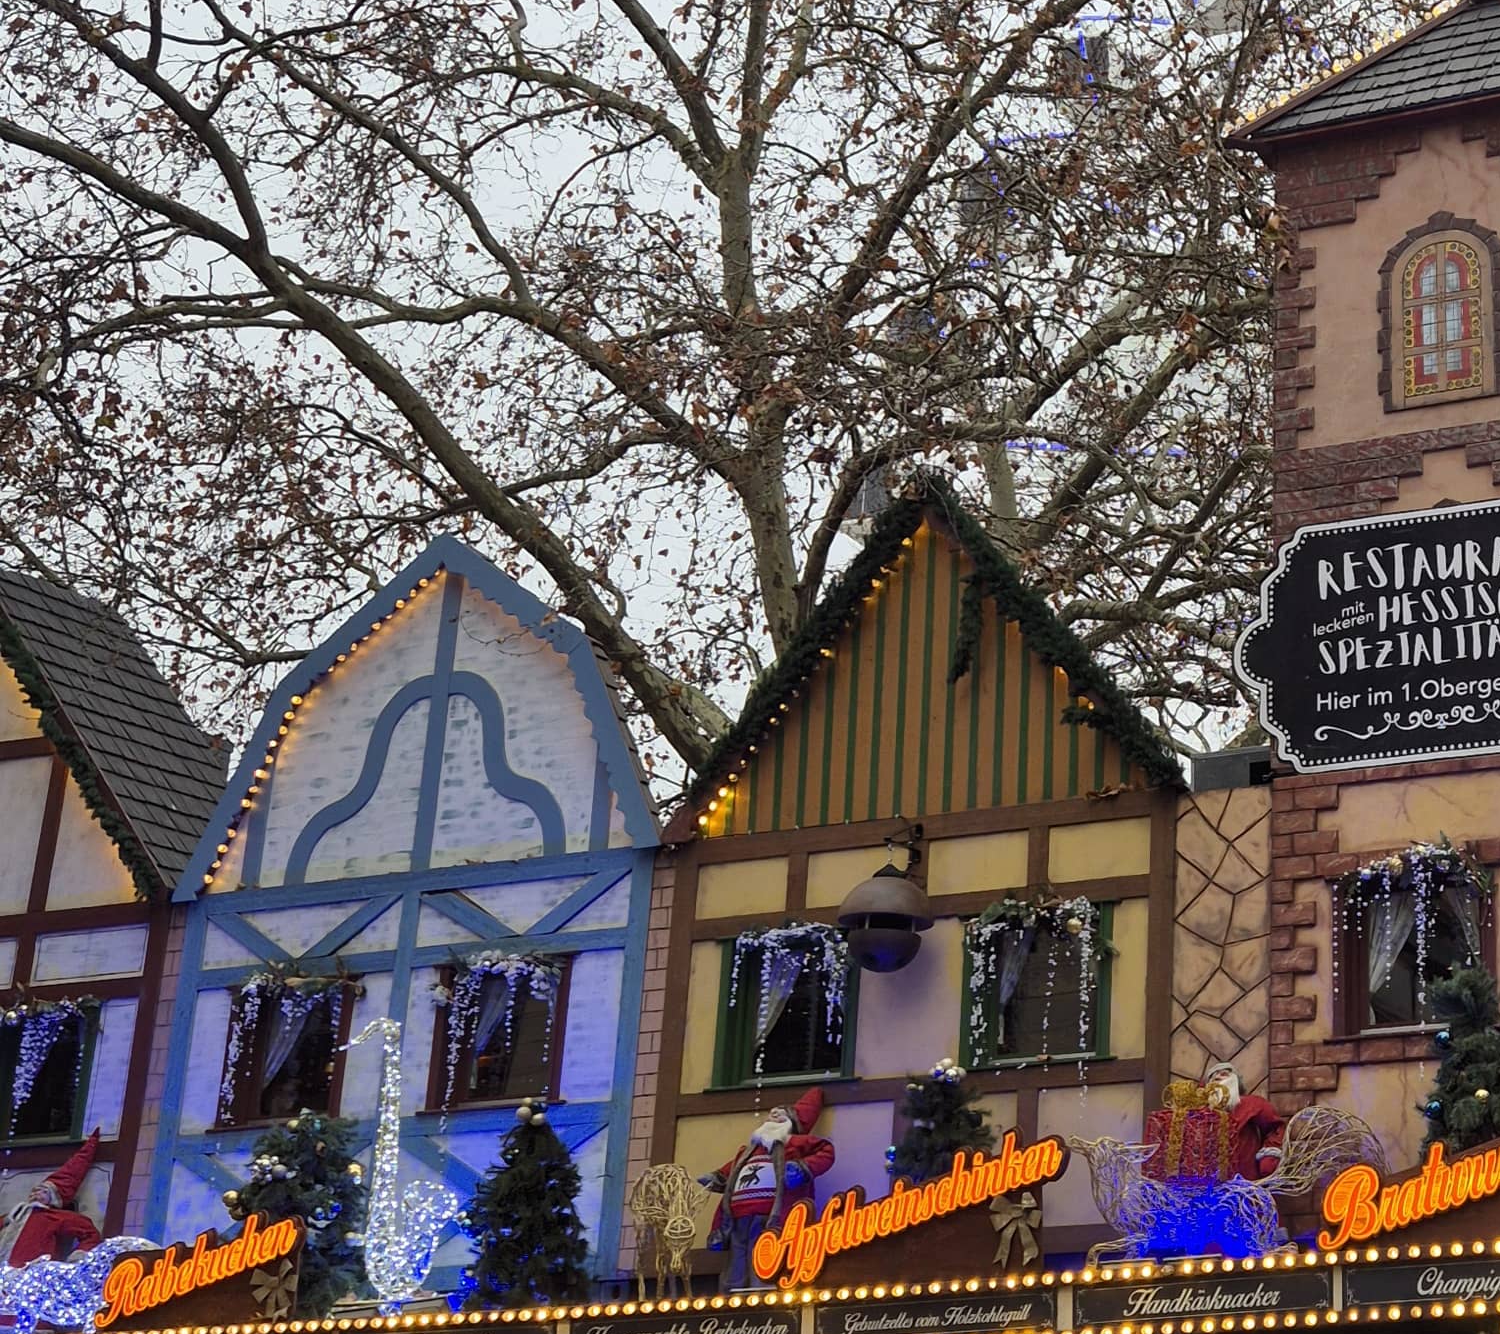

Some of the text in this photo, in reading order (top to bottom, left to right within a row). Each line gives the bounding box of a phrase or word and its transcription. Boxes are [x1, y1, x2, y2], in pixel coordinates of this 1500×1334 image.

[1312, 611, 1375, 637] leckeren
[1341, 601, 1366, 617] mit
[1316, 682, 1362, 712] Hier
[1367, 685, 1393, 708] im
[752, 1132, 1063, 1290] Apfelweinschinken
[94, 1212, 299, 1328] Reibekuchen
[1123, 1282, 1281, 1317] Handkäsknacker
[914, 1315, 940, 1327] vom
[941, 1303, 1032, 1327] Holzkohlegrill
